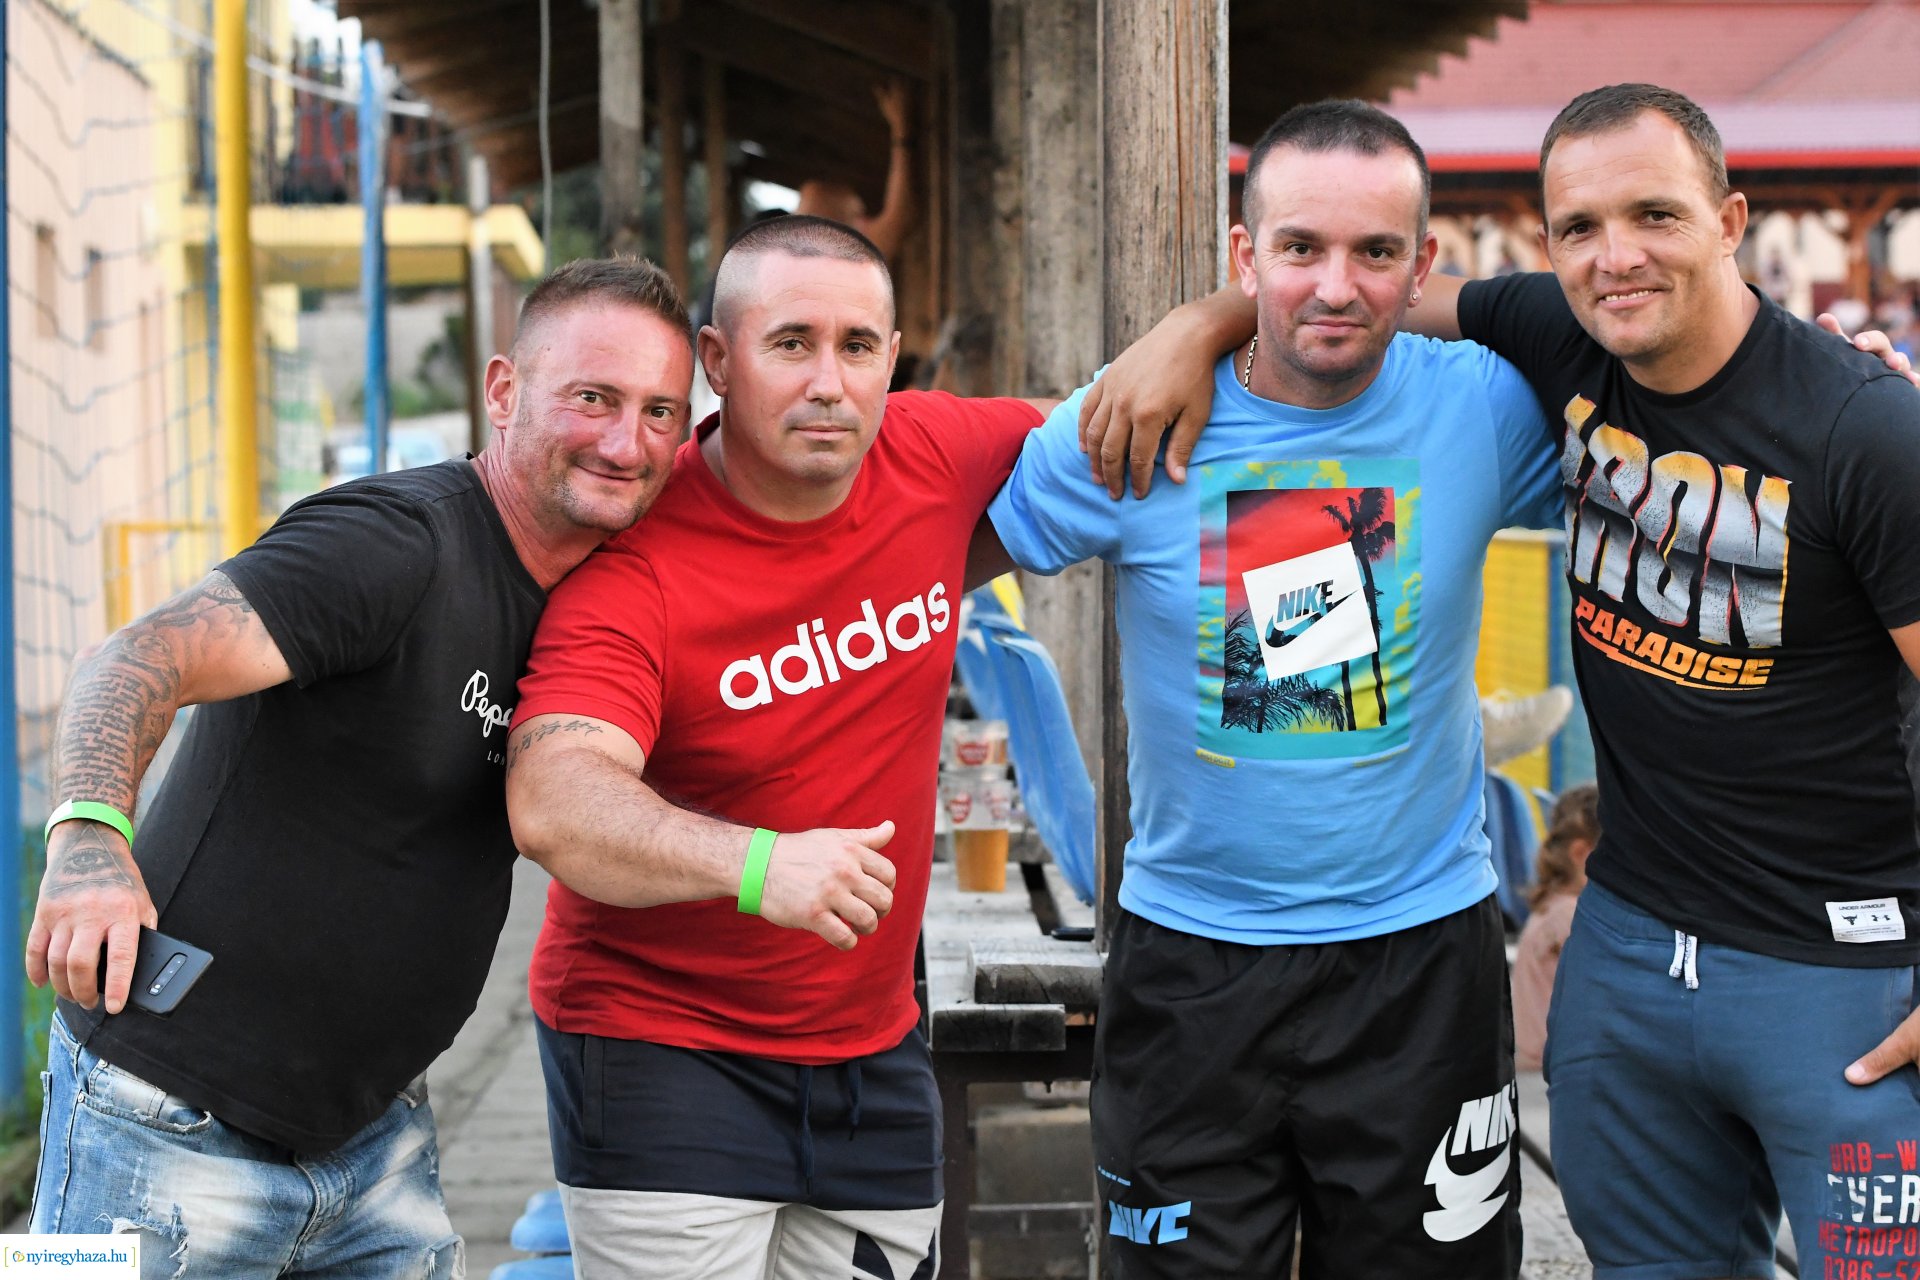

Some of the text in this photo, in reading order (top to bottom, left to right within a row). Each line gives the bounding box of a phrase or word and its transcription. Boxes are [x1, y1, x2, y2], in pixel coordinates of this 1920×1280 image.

[1559, 393, 1792, 648] IRON
[1276, 579, 1334, 624] NIKE
[1575, 596, 1775, 685] PARADISE
[719, 581, 950, 711] adidas
[1450, 1080, 1516, 1157] NIK
[1818, 1219, 1920, 1257] METROPO
